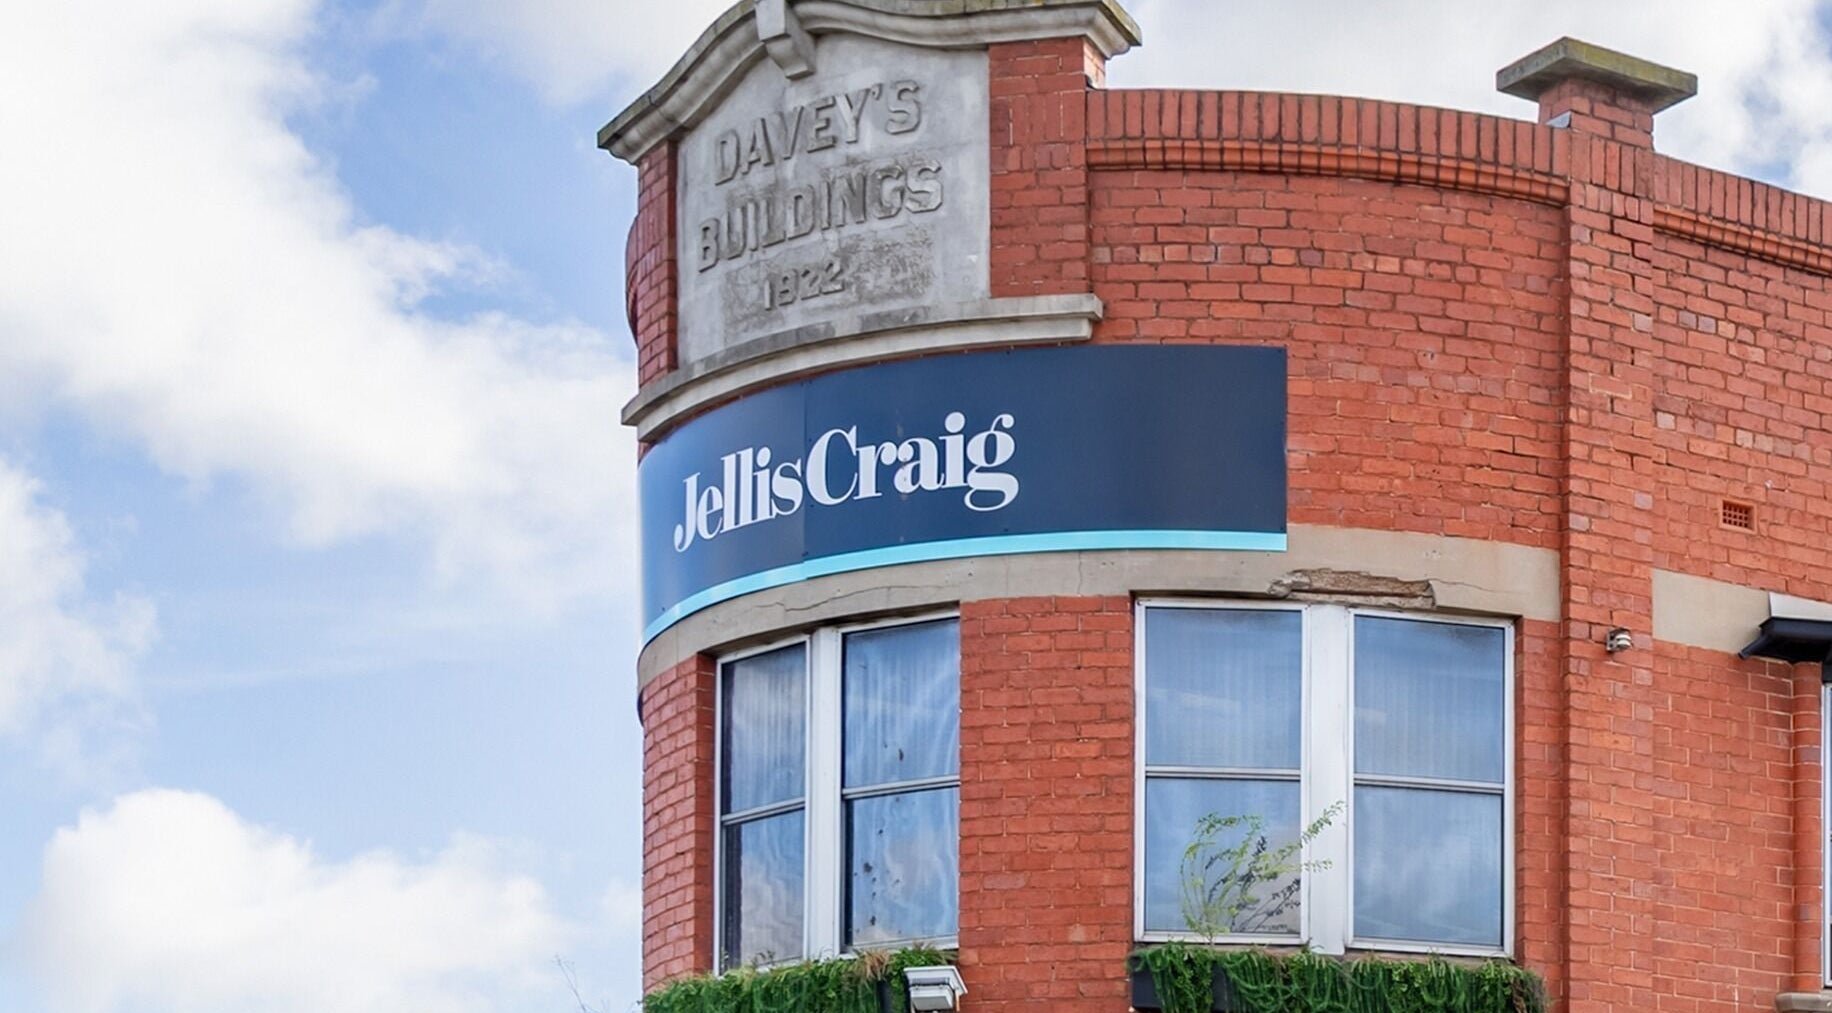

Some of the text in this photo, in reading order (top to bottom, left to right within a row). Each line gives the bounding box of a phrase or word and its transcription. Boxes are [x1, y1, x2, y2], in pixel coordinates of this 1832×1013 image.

[714, 80, 922, 186] DAVEY'S
[696, 159, 944, 273] BUILDINGS
[762, 258, 846, 311] 1922
